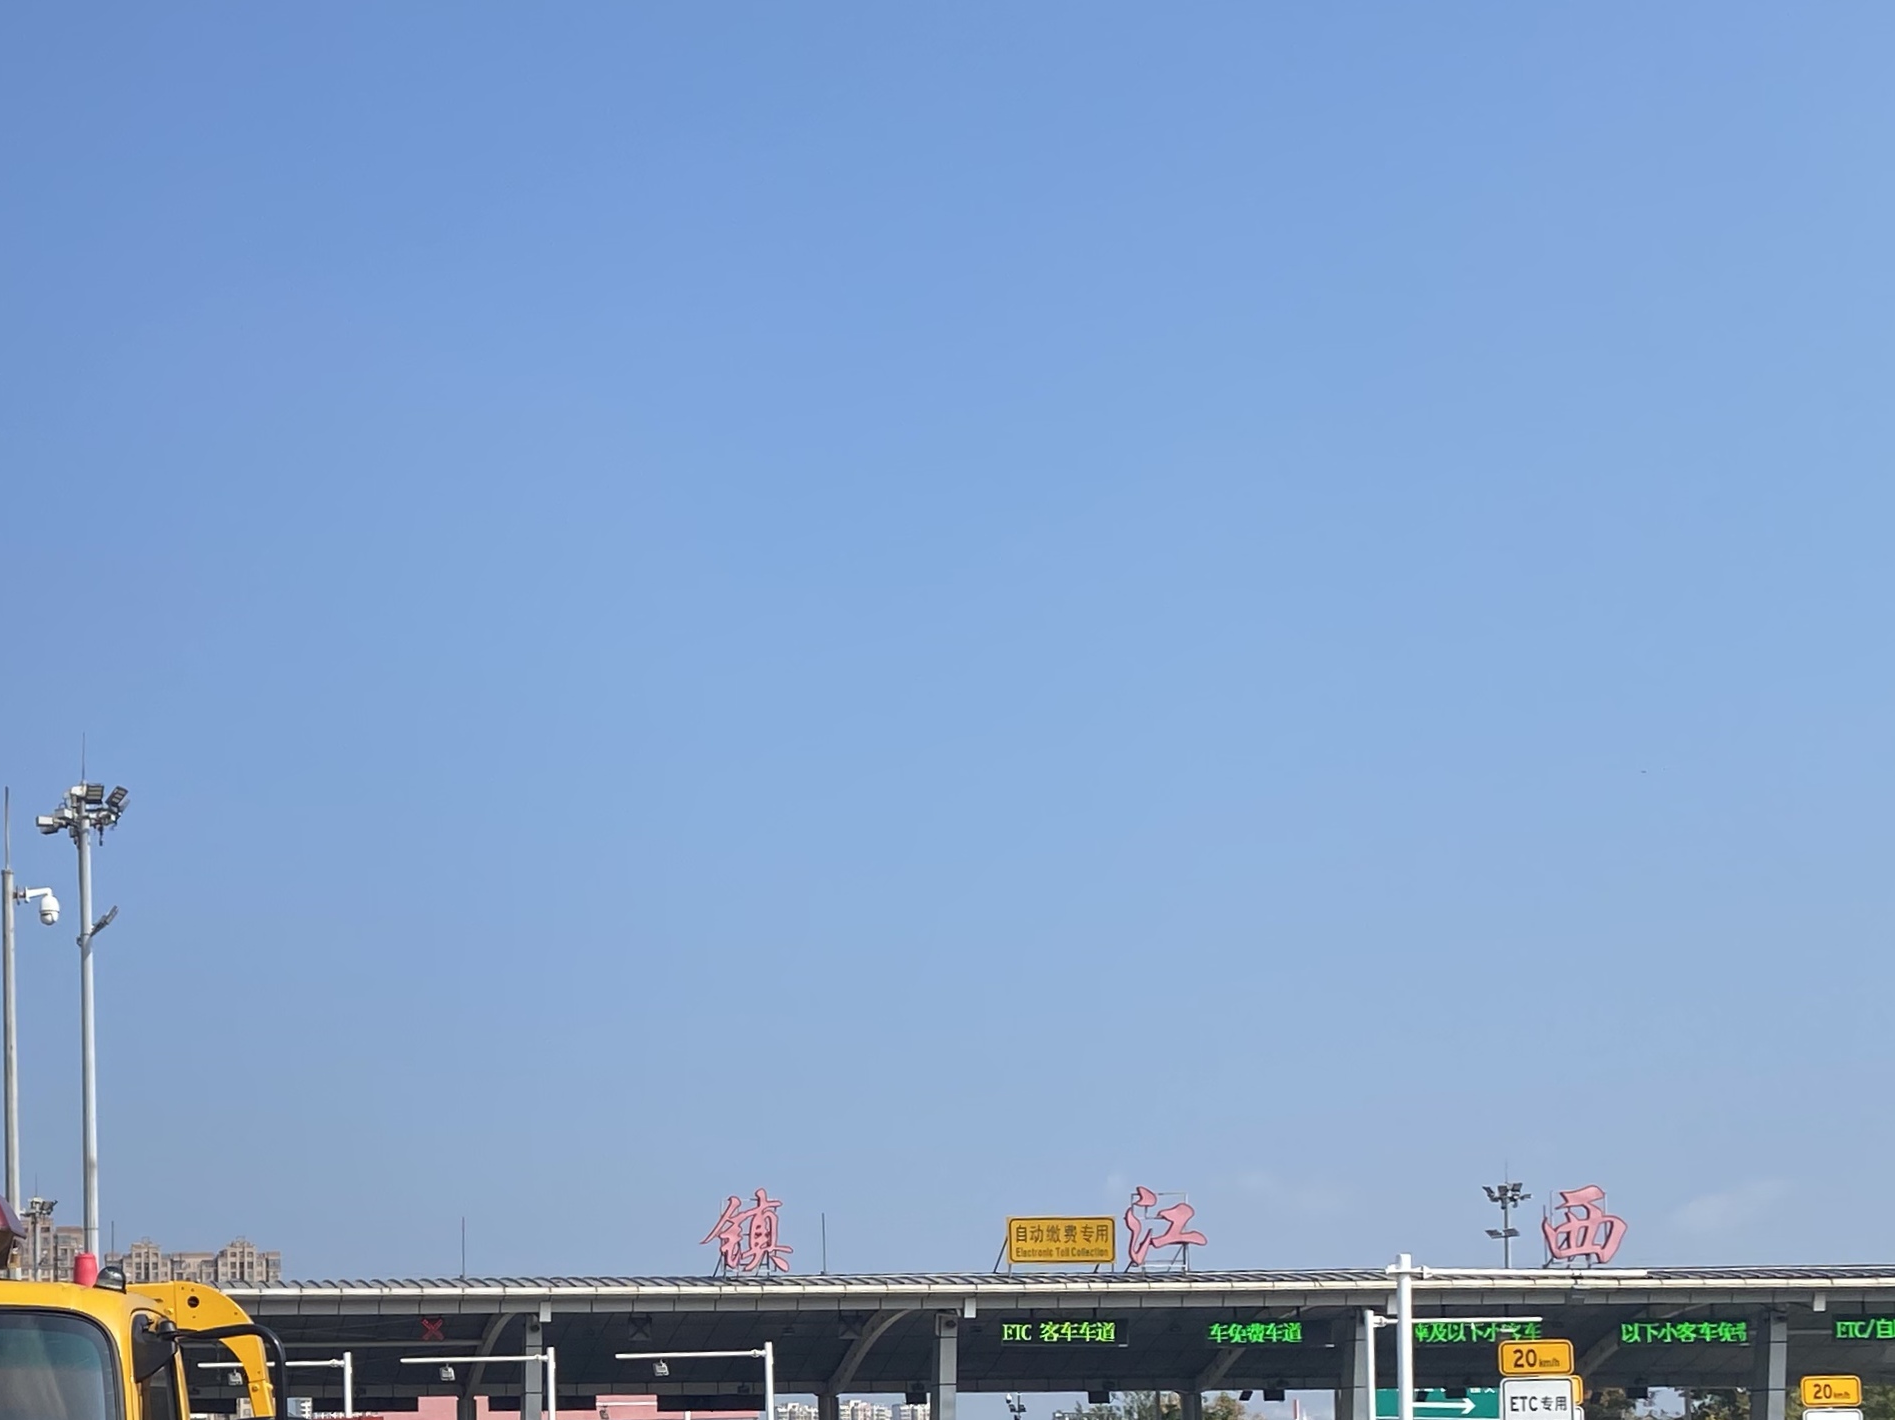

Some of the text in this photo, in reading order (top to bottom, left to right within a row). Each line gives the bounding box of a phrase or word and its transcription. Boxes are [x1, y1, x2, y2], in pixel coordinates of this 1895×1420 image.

[699, 1184, 1629, 1273] 镇 江 西
[1015, 1224, 1109, 1244] 自动缴费专用
[1015, 1247, 1109, 1258] Electronic Toll Collection
[1002, 1321, 1116, 1342] ETC 客车车道
[1835, 1318, 1895, 1339] ETC/自
[1512, 1349, 1538, 1368] 20
[1812, 1384, 1832, 1399] 20
[1510, 1395, 1568, 1412] ETC 专用
